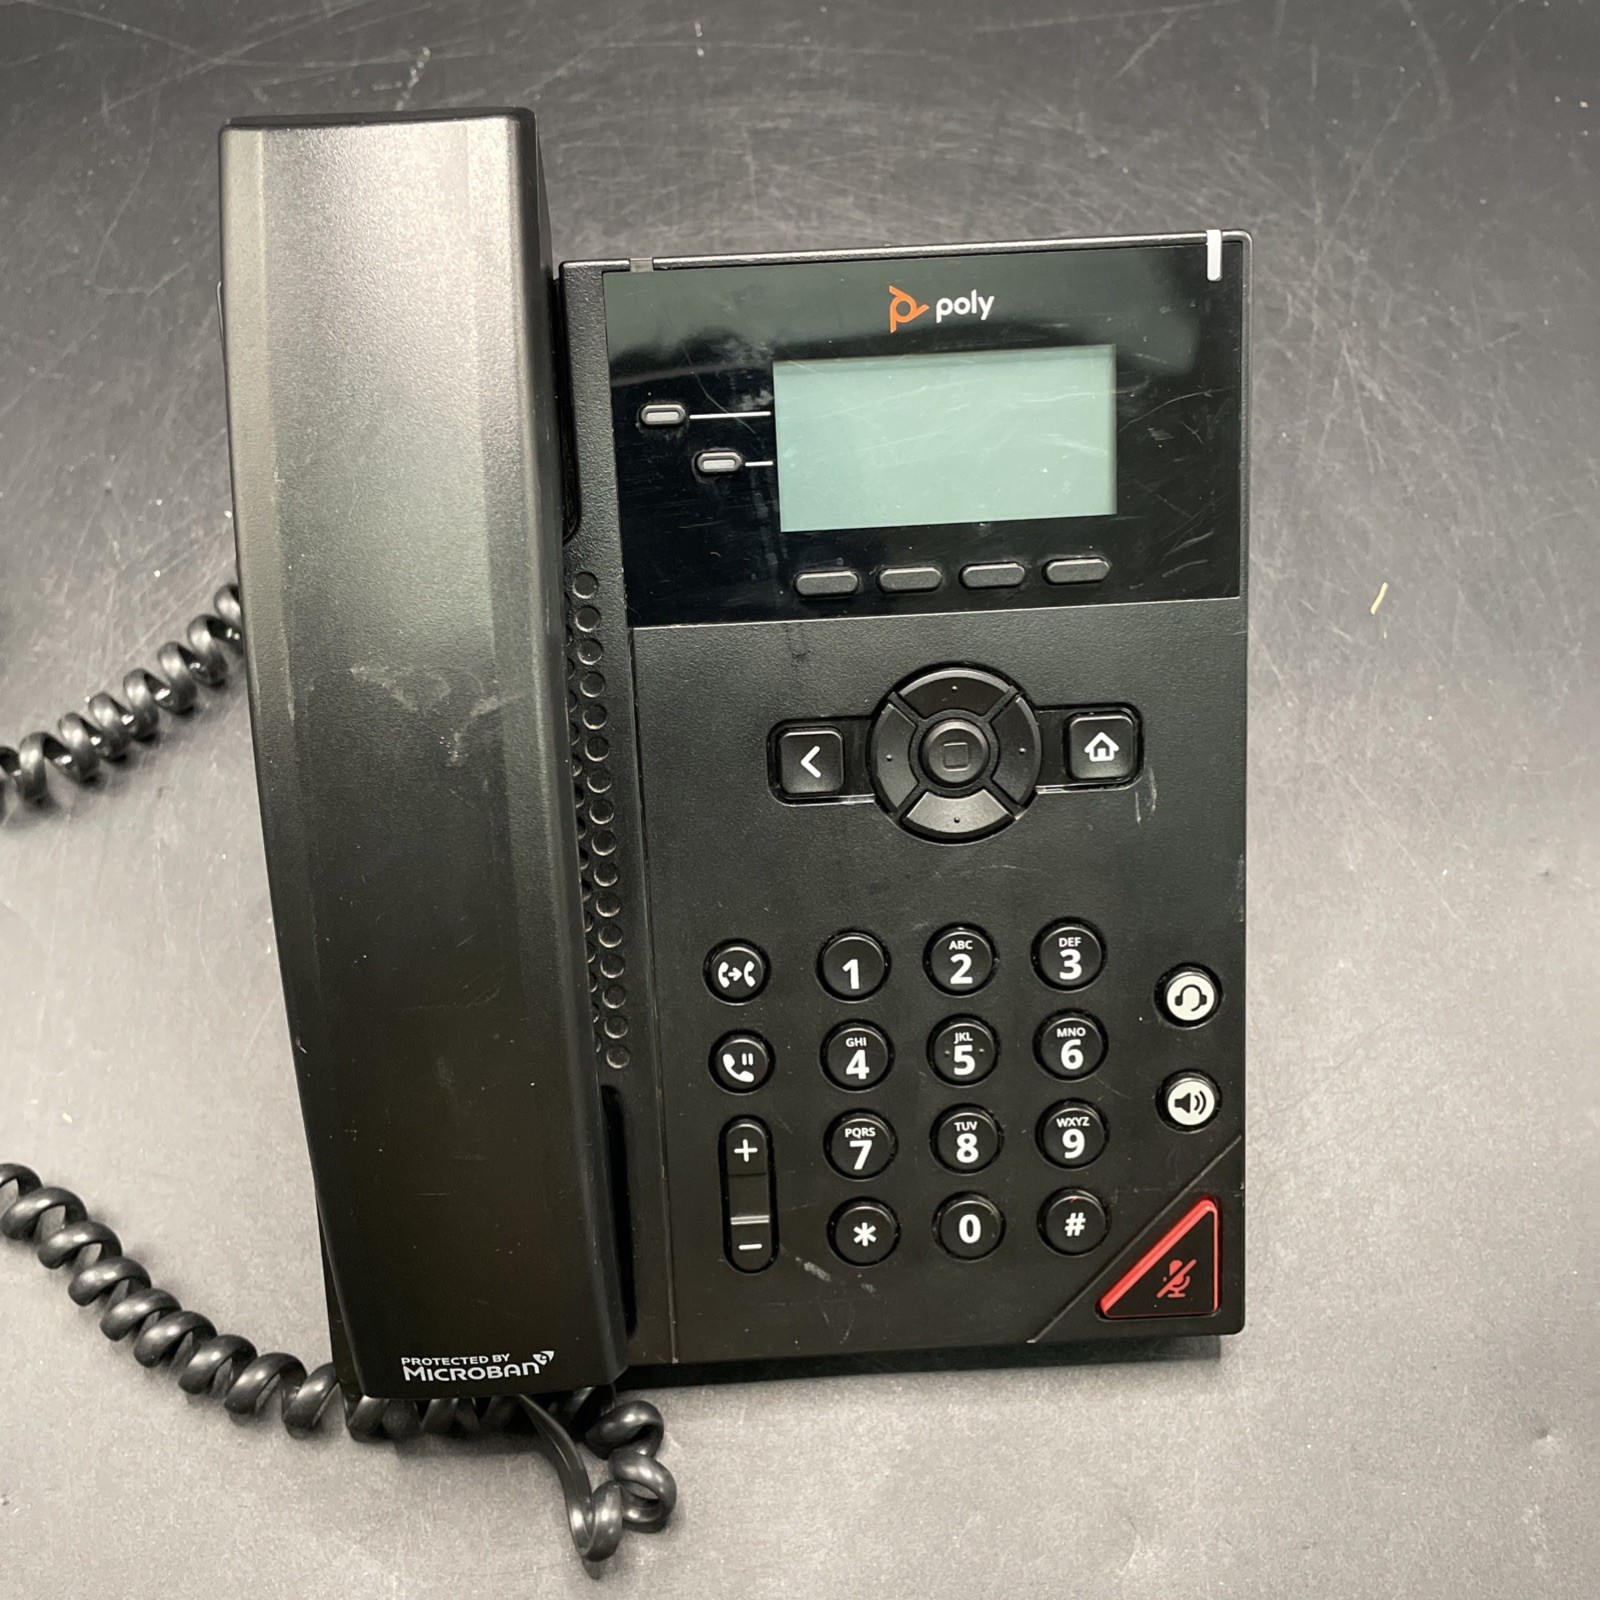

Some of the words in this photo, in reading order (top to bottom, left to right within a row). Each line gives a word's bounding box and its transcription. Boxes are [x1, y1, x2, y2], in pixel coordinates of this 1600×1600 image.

[936, 289, 995, 323] poly
[949, 940, 972, 950] ABC
[1059, 937, 1081, 947] DEF
[843, 959, 859, 989] 1
[950, 954, 973, 984] 2
[1060, 949, 1082, 980] 3
[846, 1037, 866, 1047] GHI
[954, 1032, 973, 1044] JKL
[1057, 1027, 1086, 1037] MNO
[846, 1050, 869, 1079] 4
[954, 1045, 975, 1075] 5
[1061, 1039, 1083, 1069] 6
[844, 1126, 876, 1139] PQRS
[954, 1121, 977, 1131] TUV
[1056, 1115, 1091, 1128] WXYZ
[850, 1140, 872, 1170] 7
[957, 1133, 978, 1163] 8
[1063, 1129, 1085, 1159] 9
[959, 1214, 981, 1243] 0
[401, 1356, 489, 1366] PROTECTED
[492, 1353, 510, 1363] BY
